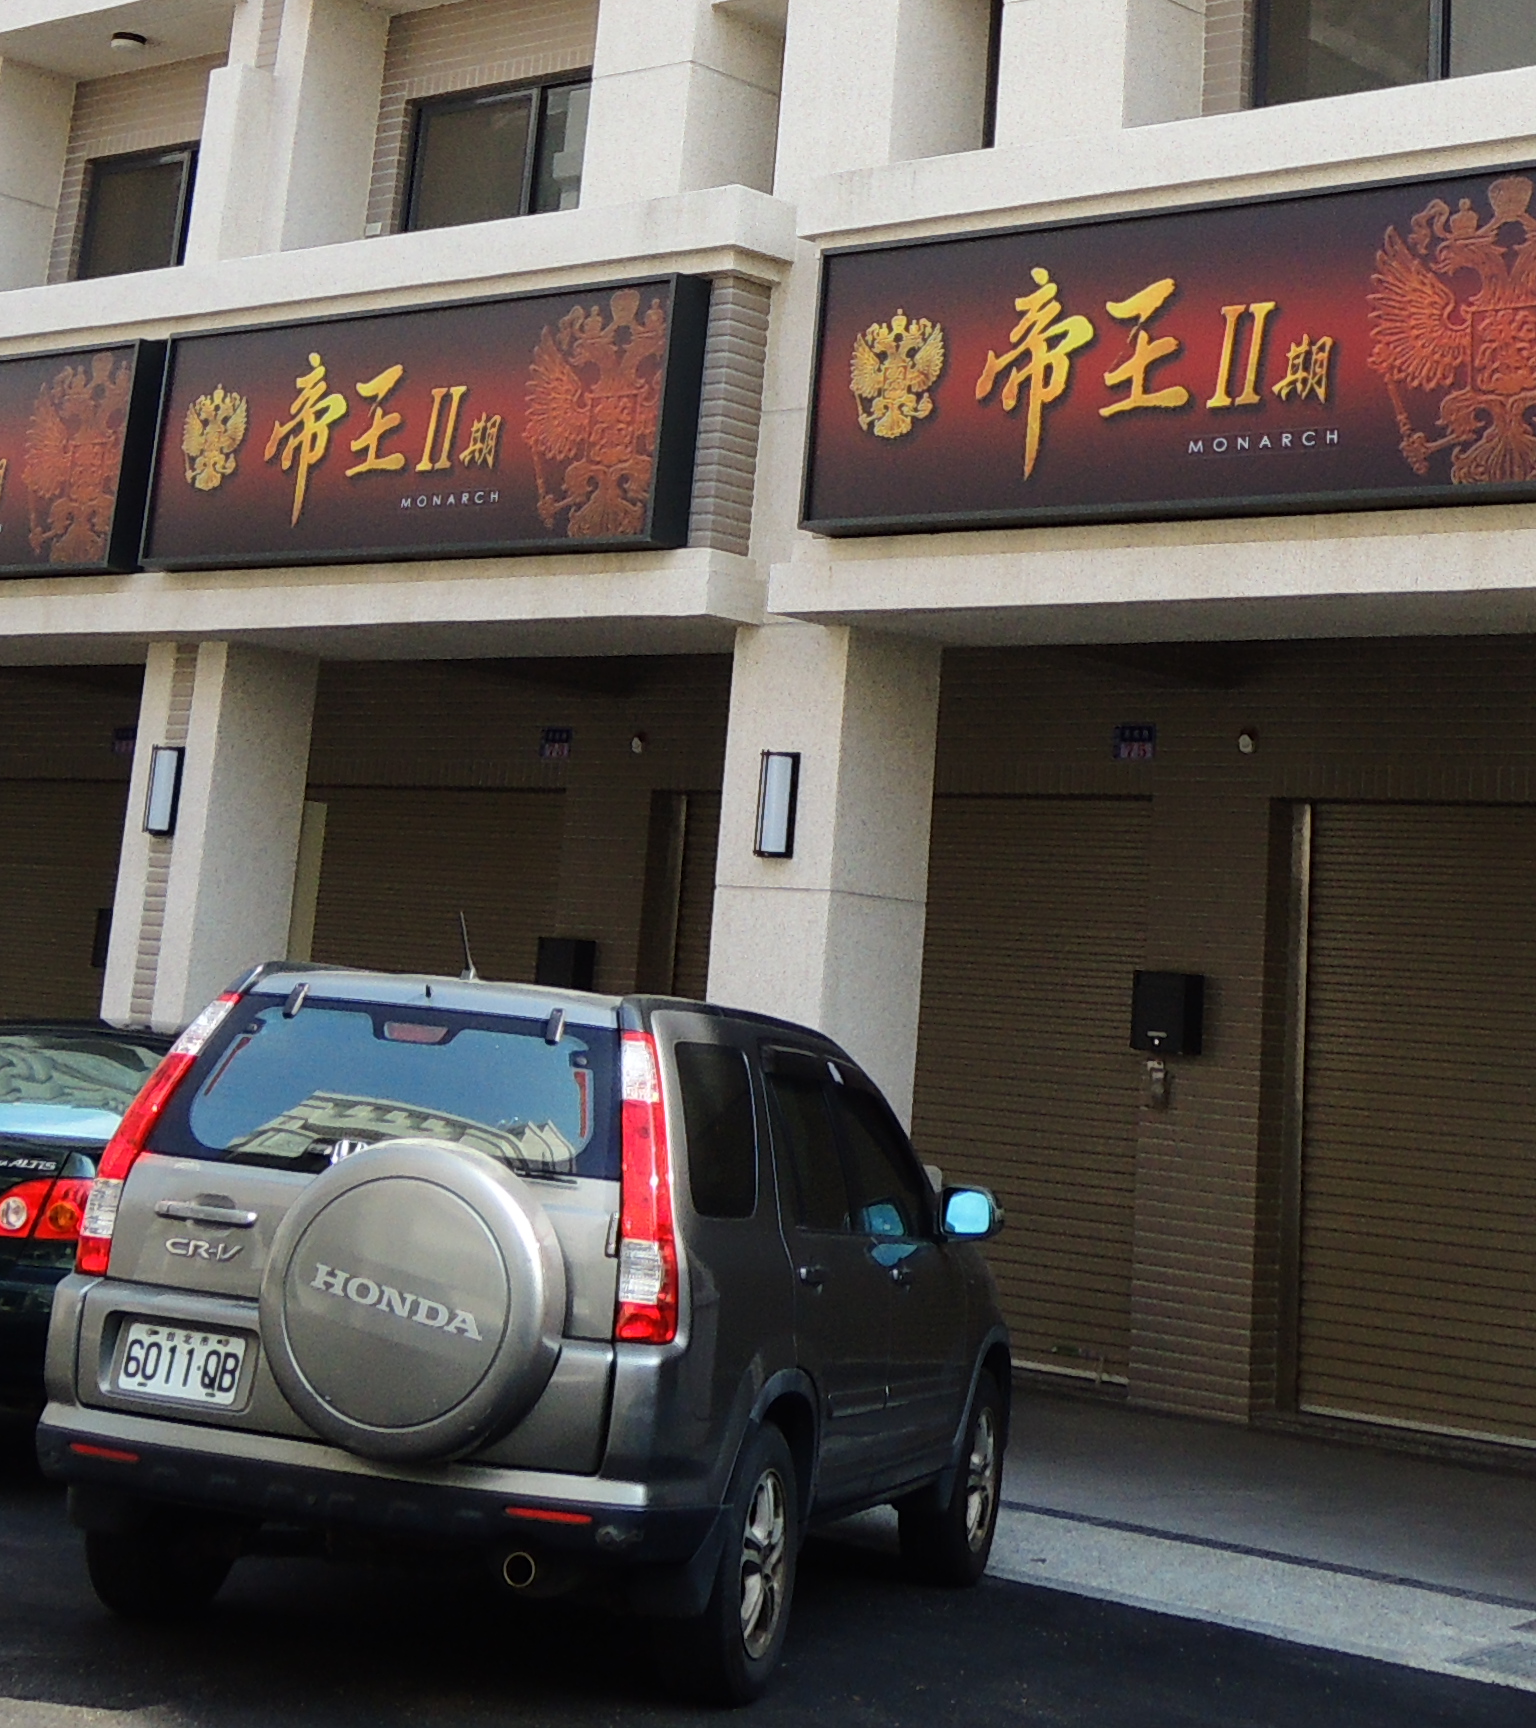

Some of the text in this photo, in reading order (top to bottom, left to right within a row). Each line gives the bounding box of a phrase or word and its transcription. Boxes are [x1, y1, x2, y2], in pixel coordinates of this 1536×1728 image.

[1187, 428, 1342, 454] MONARCH
[400, 489, 501, 509] MONARCH
[8, 1158, 57, 1171] ALTIS
[165, 1237, 244, 1262] CR-V
[310, 1262, 483, 1342] HONDA
